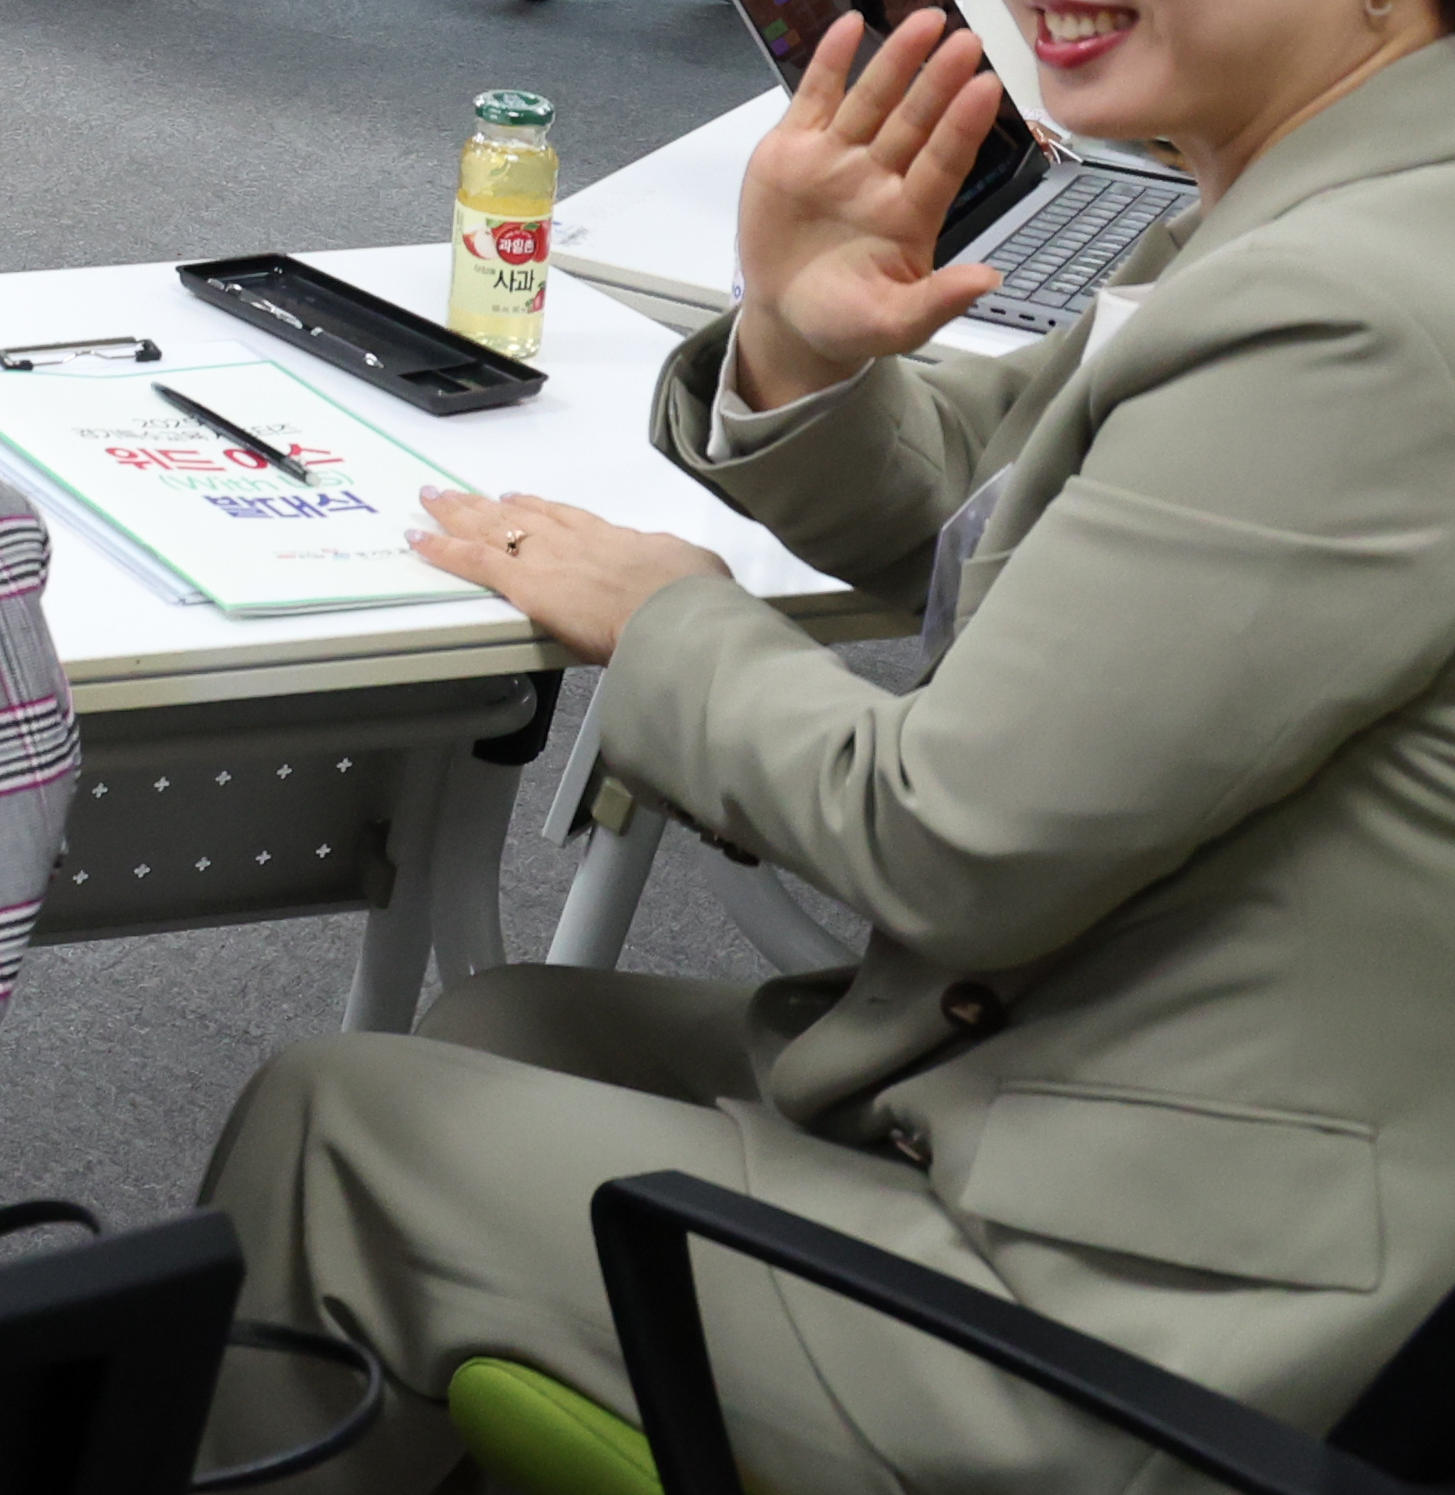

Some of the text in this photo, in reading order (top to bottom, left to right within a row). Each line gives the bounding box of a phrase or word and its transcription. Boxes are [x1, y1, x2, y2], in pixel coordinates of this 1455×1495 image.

[493, 269, 536, 292] 사과
[105, 446, 227, 471] 위드
[203, 490, 379, 519] 발대식
